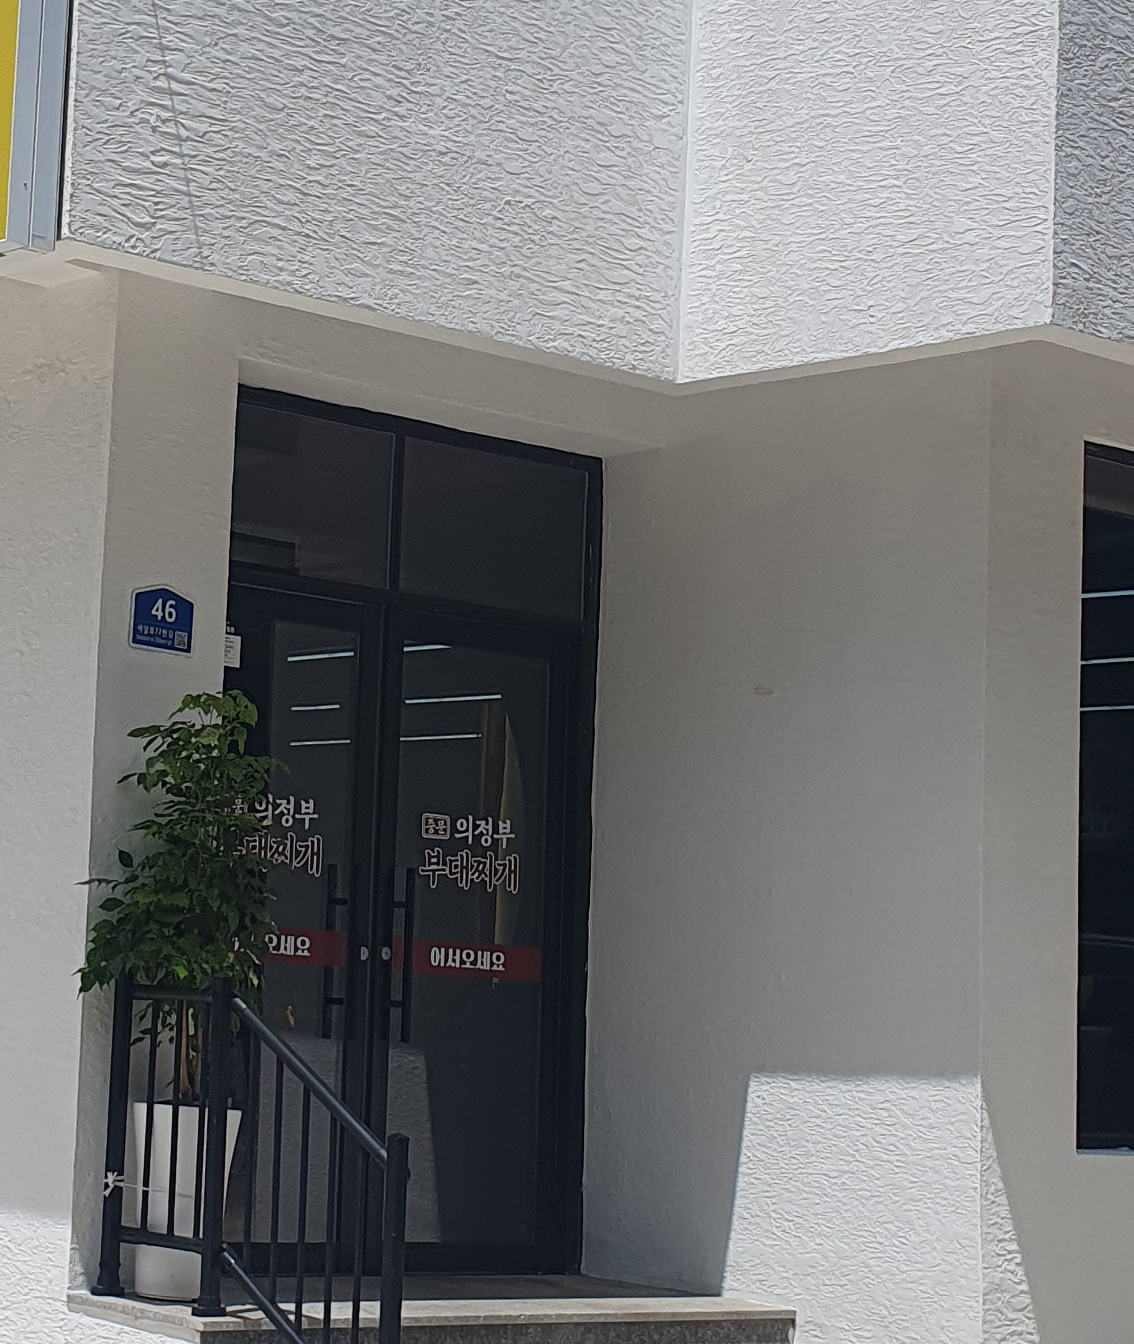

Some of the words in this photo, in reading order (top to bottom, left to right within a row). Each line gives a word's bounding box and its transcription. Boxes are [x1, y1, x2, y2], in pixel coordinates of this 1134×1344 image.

[151, 598, 177, 623] 46
[254, 793, 318, 830] 의정부
[454, 815, 515, 849] 의정부
[233, 830, 323, 877] 대찌개
[419, 847, 519, 894] 부대찌개
[430, 946, 505, 971] 어서오세요
